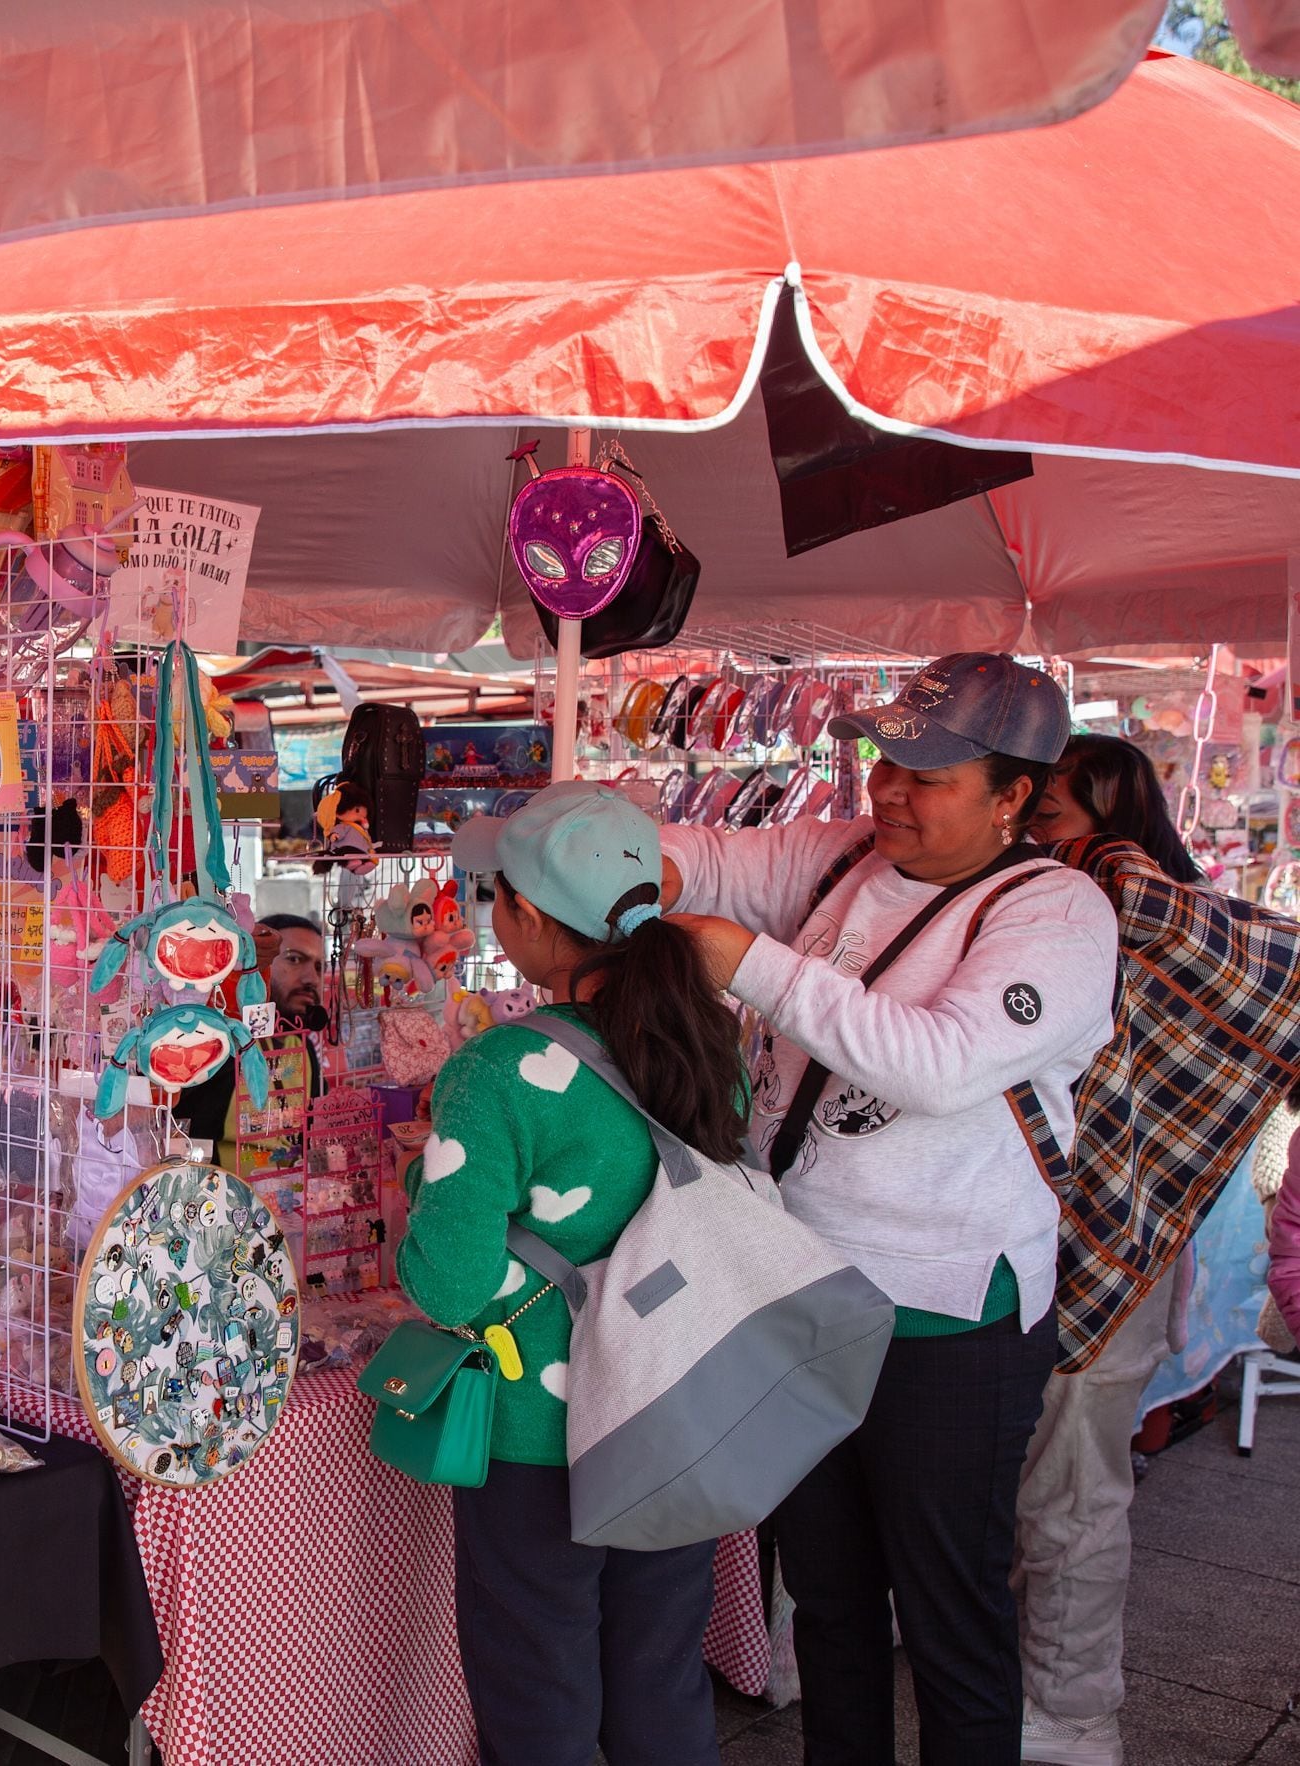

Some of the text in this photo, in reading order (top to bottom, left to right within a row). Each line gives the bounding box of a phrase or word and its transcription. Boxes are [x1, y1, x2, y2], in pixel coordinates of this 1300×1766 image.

[146, 497, 242, 530] QUE TE TATUES
[133, 517, 223, 555] LA COLA
[118, 554, 148, 569] OMO
[153, 554, 179, 569] DIJO
[199, 562, 231, 586] MAMÁ
[1008, 992, 1036, 1020] 100
